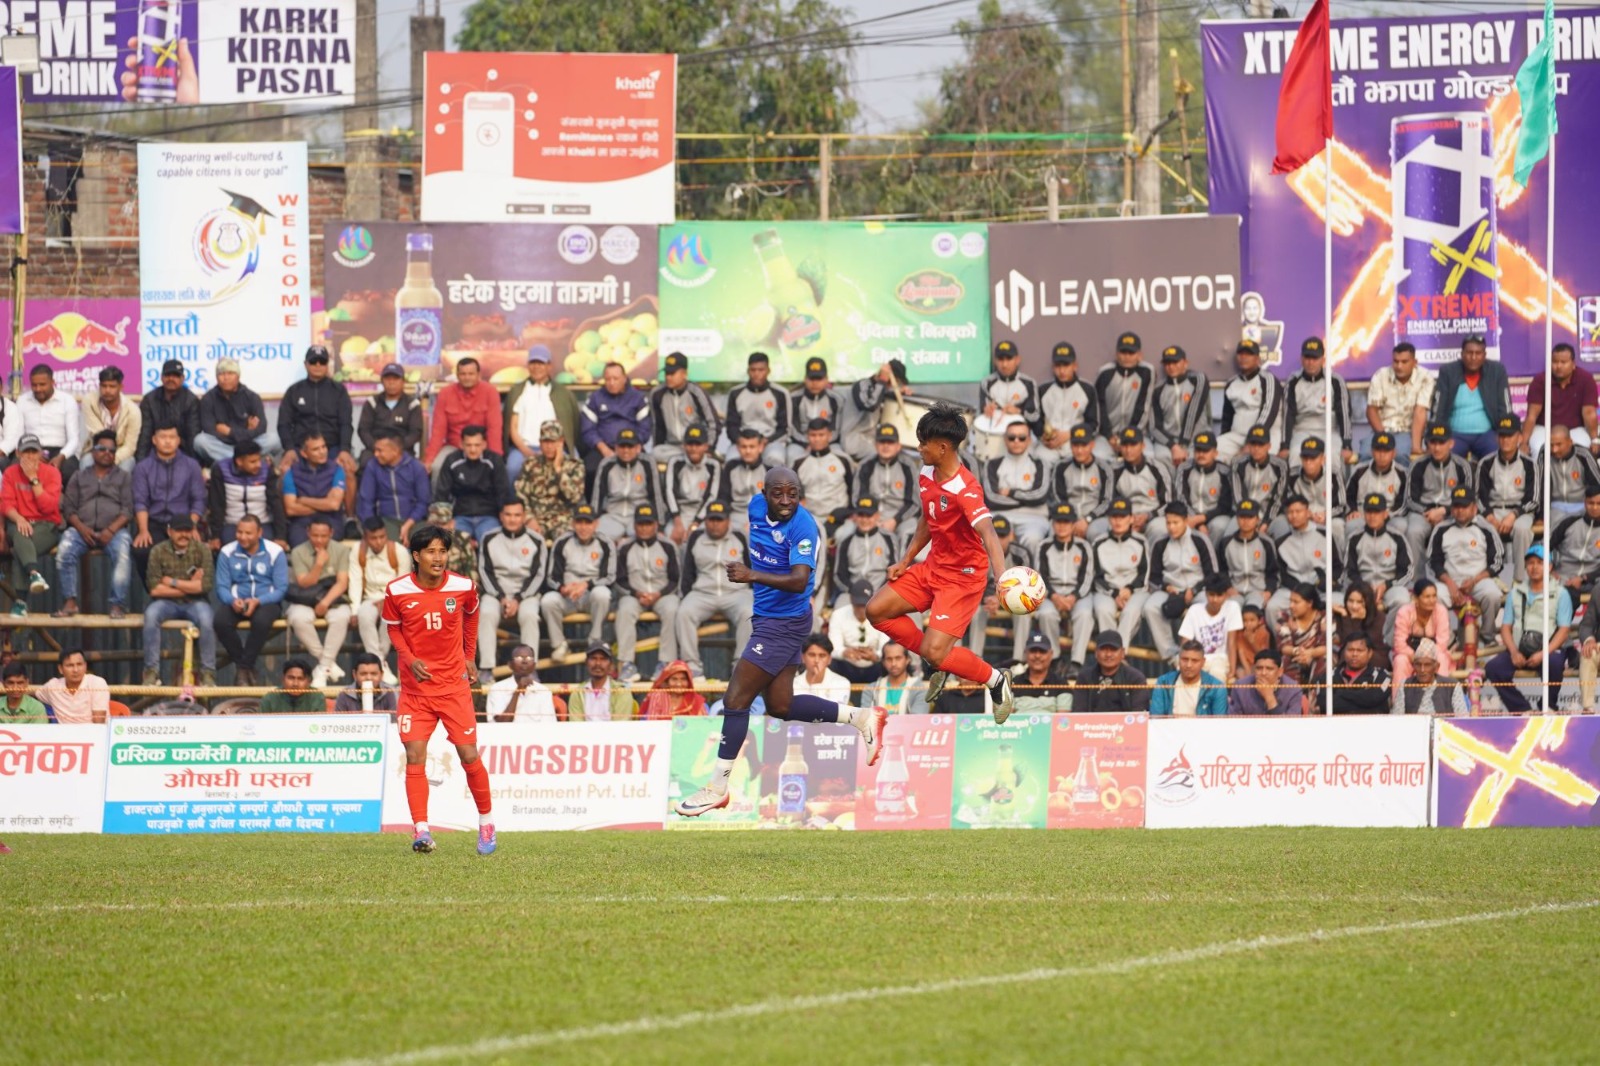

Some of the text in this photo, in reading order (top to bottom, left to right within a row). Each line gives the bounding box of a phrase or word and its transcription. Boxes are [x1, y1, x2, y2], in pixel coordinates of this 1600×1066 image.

[240, 8, 338, 34] KARKI
[227, 38, 352, 64] KIRANA
[1243, 27, 1379, 75] XTME
[1389, 20, 1515, 69] ENERGY
[33, 61, 118, 95] DRINK
[237, 68, 342, 94] PASAL
[615, 77, 656, 90] khalti
[1364, 78, 1435, 104] झापा
[1444, 70, 1570, 99] गोल्डप
[214, 151, 274, 162] well-cultured
[277, 151, 283, 161] &
[157, 166, 193, 178] capable
[196, 165, 231, 177] citizens
[234, 166, 242, 176] is
[245, 167, 260, 176] our
[277, 194, 299, 327] WELCOME
[447, 274, 630, 312] हरेक घुटमा ताजगी !
[1040, 274, 1235, 316] LEAPMOTOR
[1398, 292, 1495, 320] XTREME
[145, 311, 200, 337] सातौ
[1407, 319, 1452, 330] ENERGY
[1453, 317, 1488, 329] DRINK
[146, 344, 200, 362] झापा
[1424, 352, 1462, 361] CLASSIC
[424, 612, 442, 631] 15
[127, 725, 186, 735] 9852622224
[321, 725, 380, 734] 9709882777
[236, 747, 292, 762] PRASIK
[295, 746, 378, 763] PHARMACY
[164, 768, 313, 789] औषधी पसल
[1199, 753, 1425, 795] राष्ट्रिय खेलकुद परिषद नेपाल
[464, 782, 651, 800] Eertainment Pvt. Ltd.
[512, 804, 587, 816] Birtamode, Jhapa
[10, 814, 44, 827] सहितको
